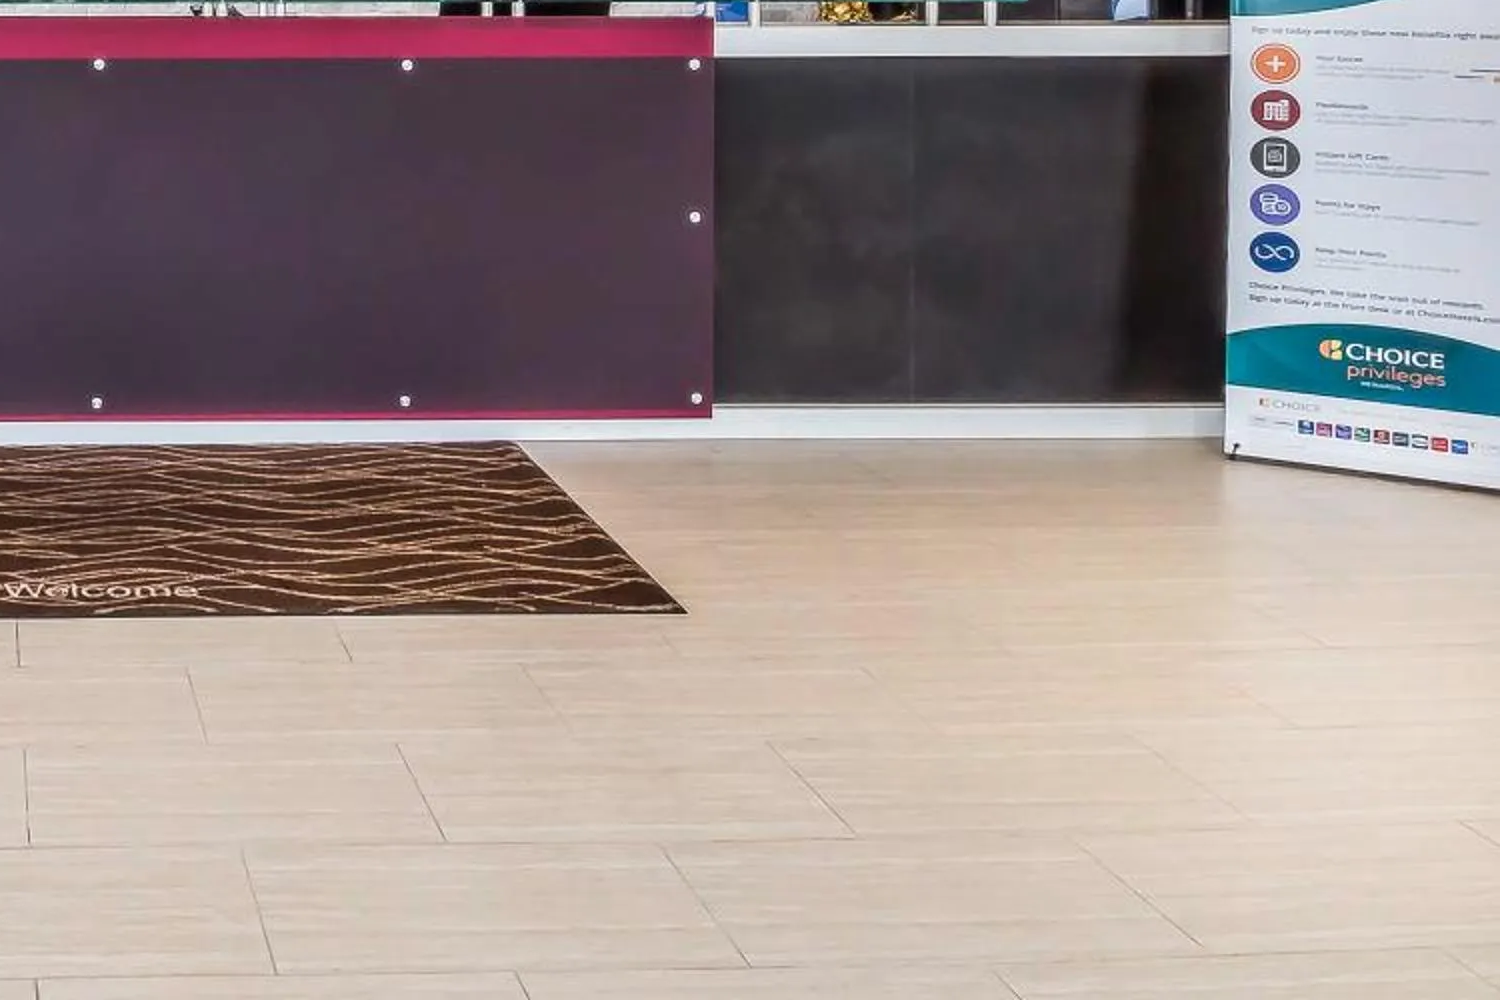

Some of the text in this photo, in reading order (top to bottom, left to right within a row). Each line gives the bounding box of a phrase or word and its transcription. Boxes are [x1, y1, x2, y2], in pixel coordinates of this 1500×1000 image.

[1345, 343, 1445, 370] CHOICE
[1347, 364, 1446, 388] privileges
[3, 582, 201, 600] Welcome
